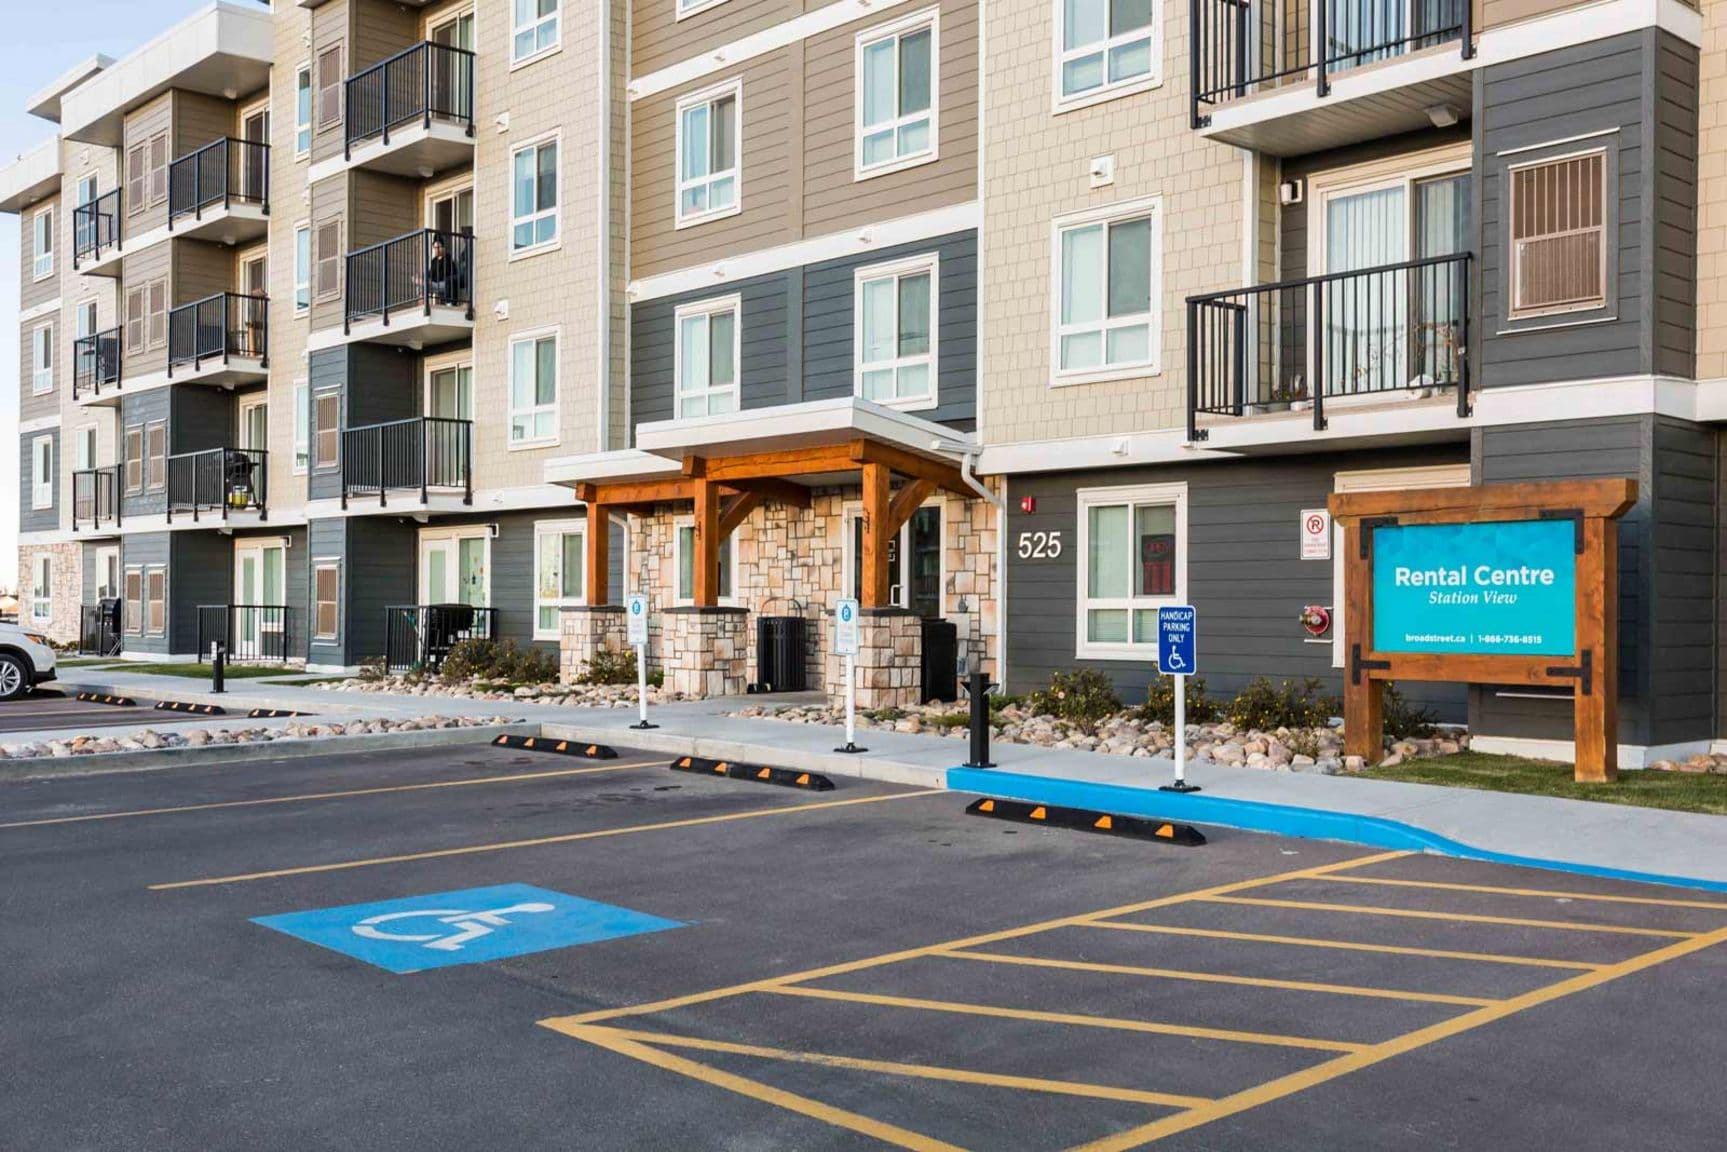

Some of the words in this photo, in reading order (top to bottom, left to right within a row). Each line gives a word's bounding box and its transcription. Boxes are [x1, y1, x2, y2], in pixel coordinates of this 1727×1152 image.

[1018, 532, 1061, 559] 525
[1395, 566, 1467, 586] Rental
[1475, 565, 1555, 586] Centre
[1428, 590, 1479, 605] Station
[1484, 590, 1517, 604] View
[1160, 611, 1193, 621] HANDICAP
[1163, 622, 1191, 632] PARKING
[1168, 633, 1185, 643] ONLY
[1405, 633, 1466, 643] broadstreet.ca
